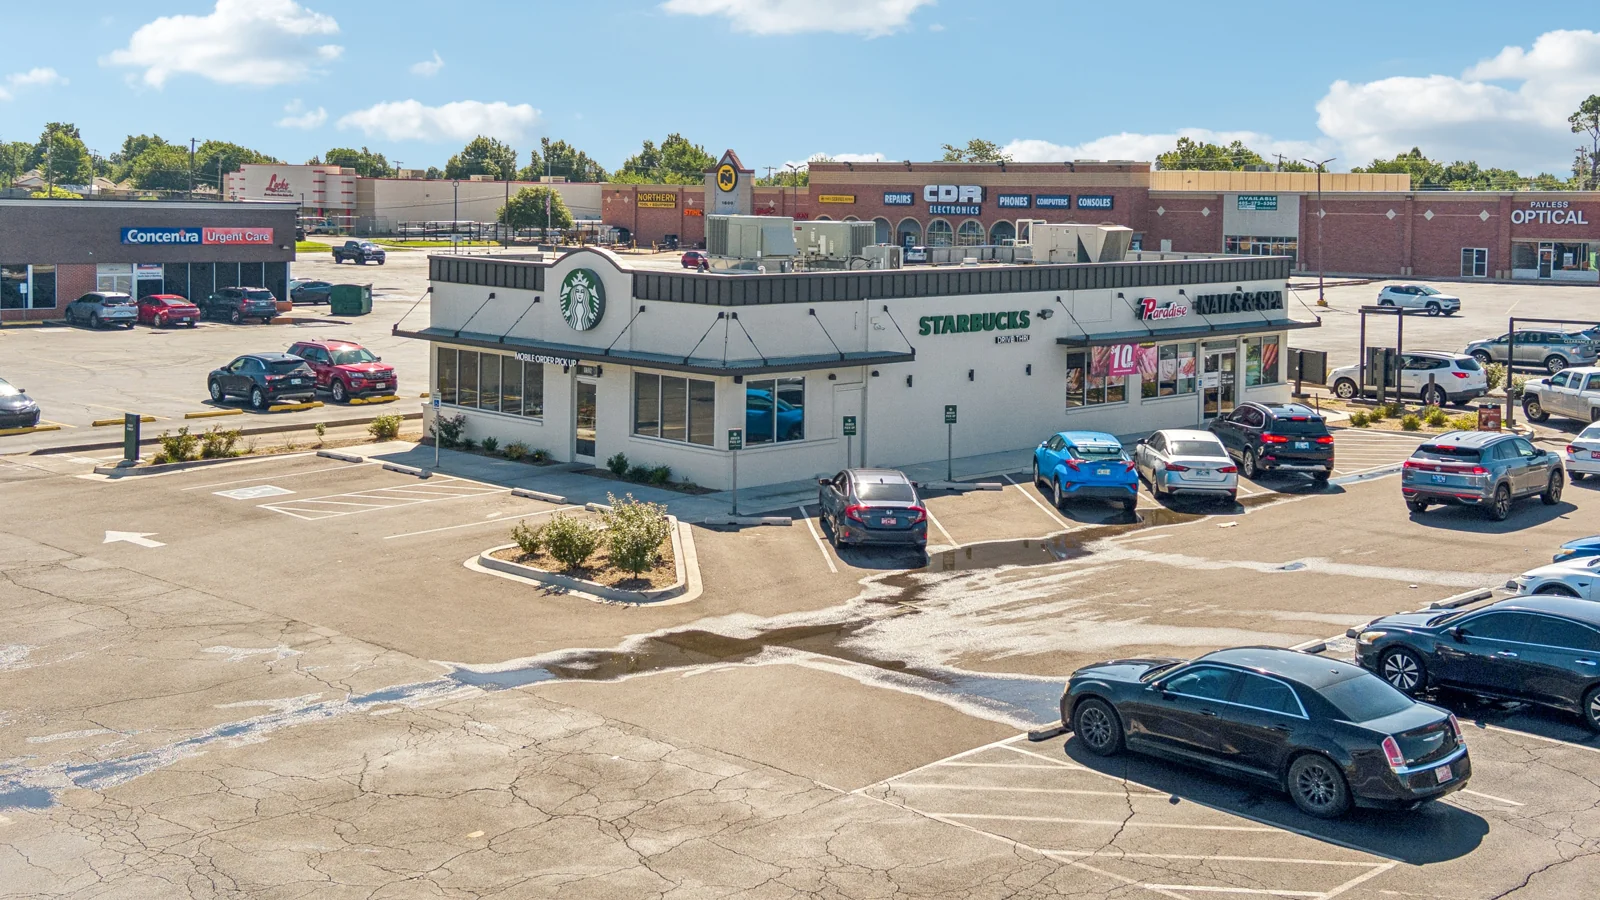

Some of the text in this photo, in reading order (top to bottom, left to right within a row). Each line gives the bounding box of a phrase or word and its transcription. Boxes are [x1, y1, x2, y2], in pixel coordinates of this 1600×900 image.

[637, 193, 676, 202] NORTHERN
[884, 194, 912, 204] REPAIRS
[923, 184, 982, 203] CDR
[999, 196, 1028, 206] PHONES
[1036, 198, 1068, 206] COMPUTERS
[1078, 198, 1111, 207] CONSOLES
[683, 208, 702, 216] STIHL
[929, 205, 980, 215] ELECTRONICS
[1511, 209, 1589, 225] OPTICAL
[127, 229, 199, 243] Concentra
[207, 231, 270, 243] Urgent Care
[1197, 293, 1242, 315] NAILS
[1256, 290, 1284, 311] SPA
[1140, 297, 1188, 320] Paradise
[918, 310, 1031, 336] STARBUCKS
[996, 335, 1015, 344] DRIVE
[515, 352, 577, 368] MOBILE ORDER PICK UP
